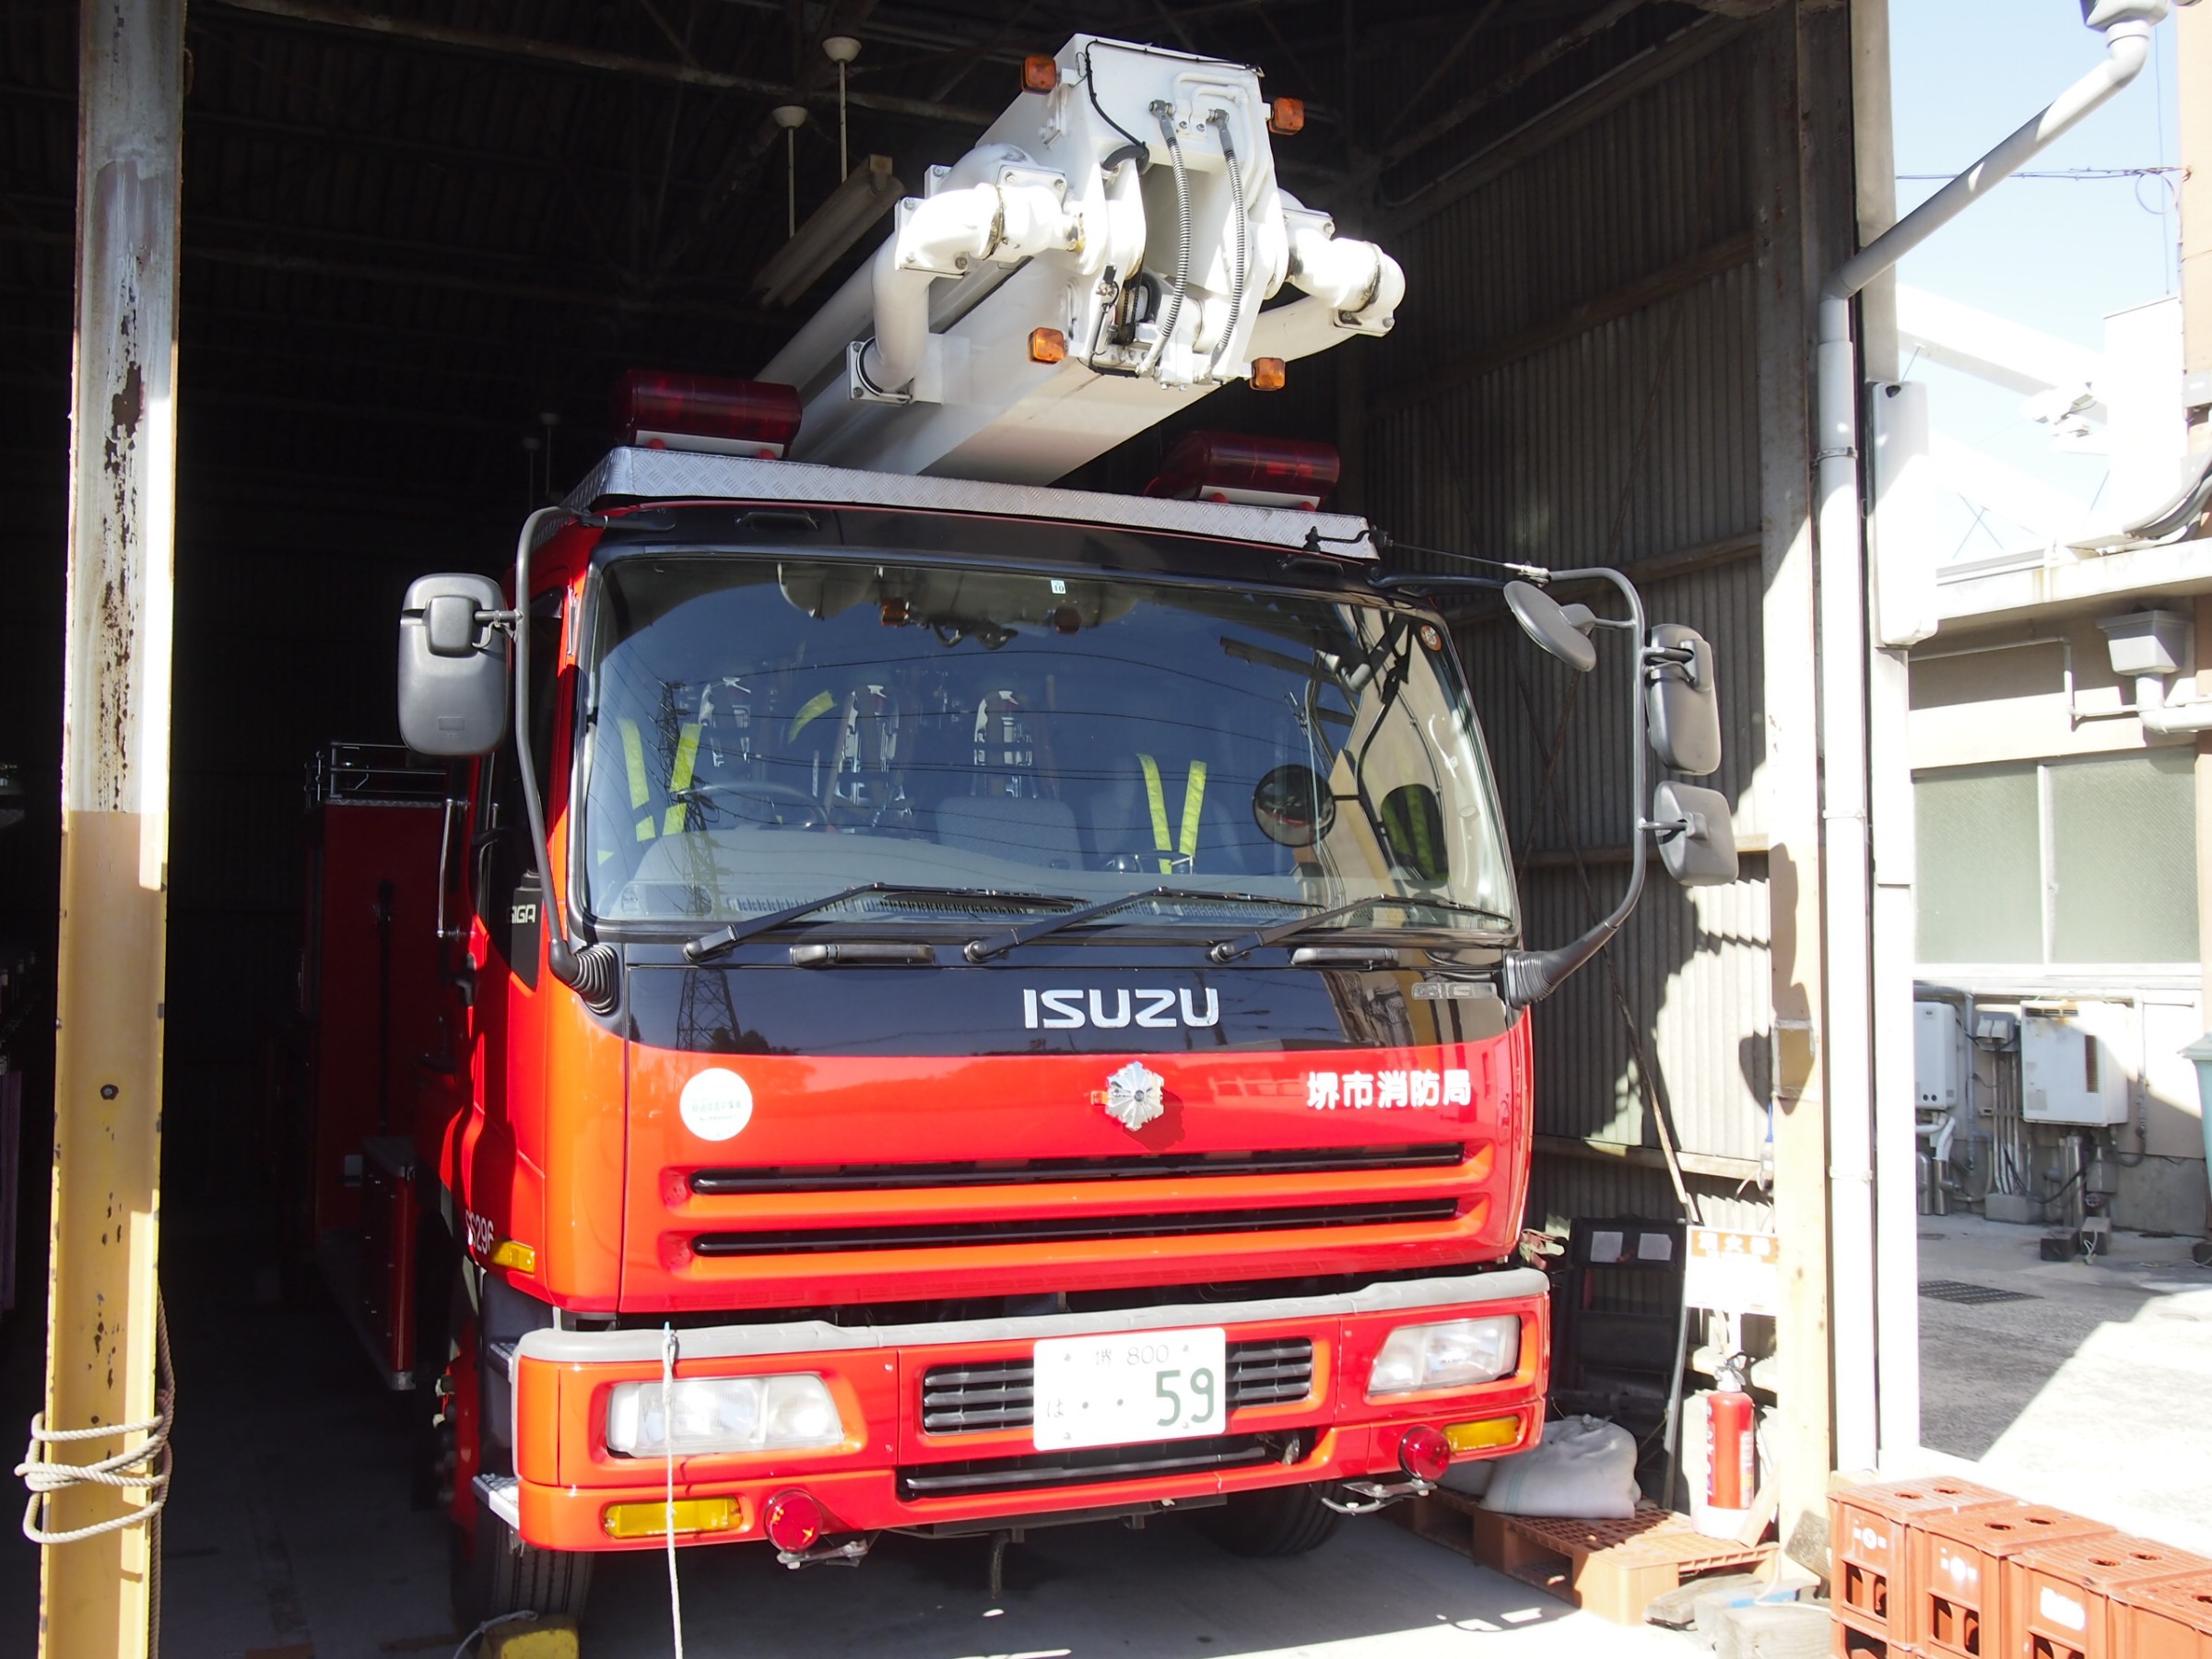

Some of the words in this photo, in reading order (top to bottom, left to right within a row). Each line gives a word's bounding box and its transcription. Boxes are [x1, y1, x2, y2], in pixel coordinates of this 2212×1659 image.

[1023, 987, 1219, 1030] ISUZU
[1306, 1069, 1472, 1110] 堺市消防局
[1126, 1344, 1170, 1366] 800
